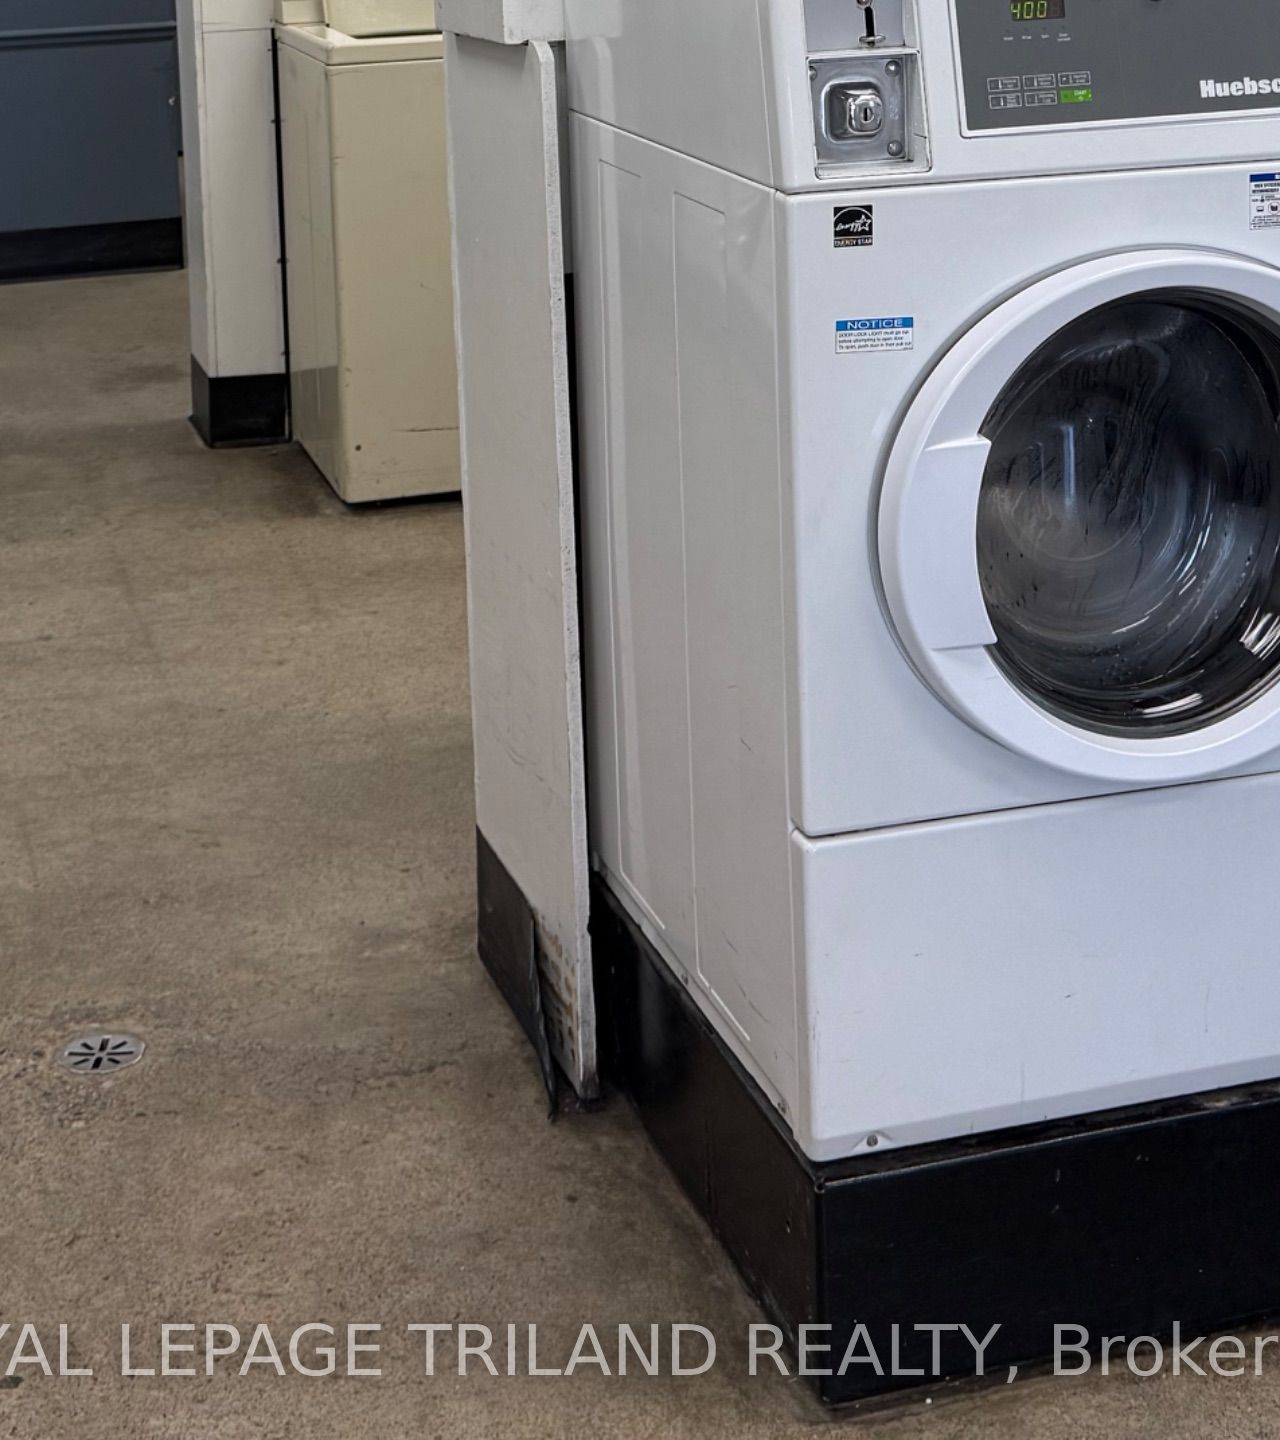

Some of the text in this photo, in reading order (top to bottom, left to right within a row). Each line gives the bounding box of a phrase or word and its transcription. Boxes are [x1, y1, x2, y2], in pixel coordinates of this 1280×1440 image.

[1011, 0, 1047, 19] 400
[834, 239, 856, 247] ENERGY
[847, 320, 903, 329] NOTICE
